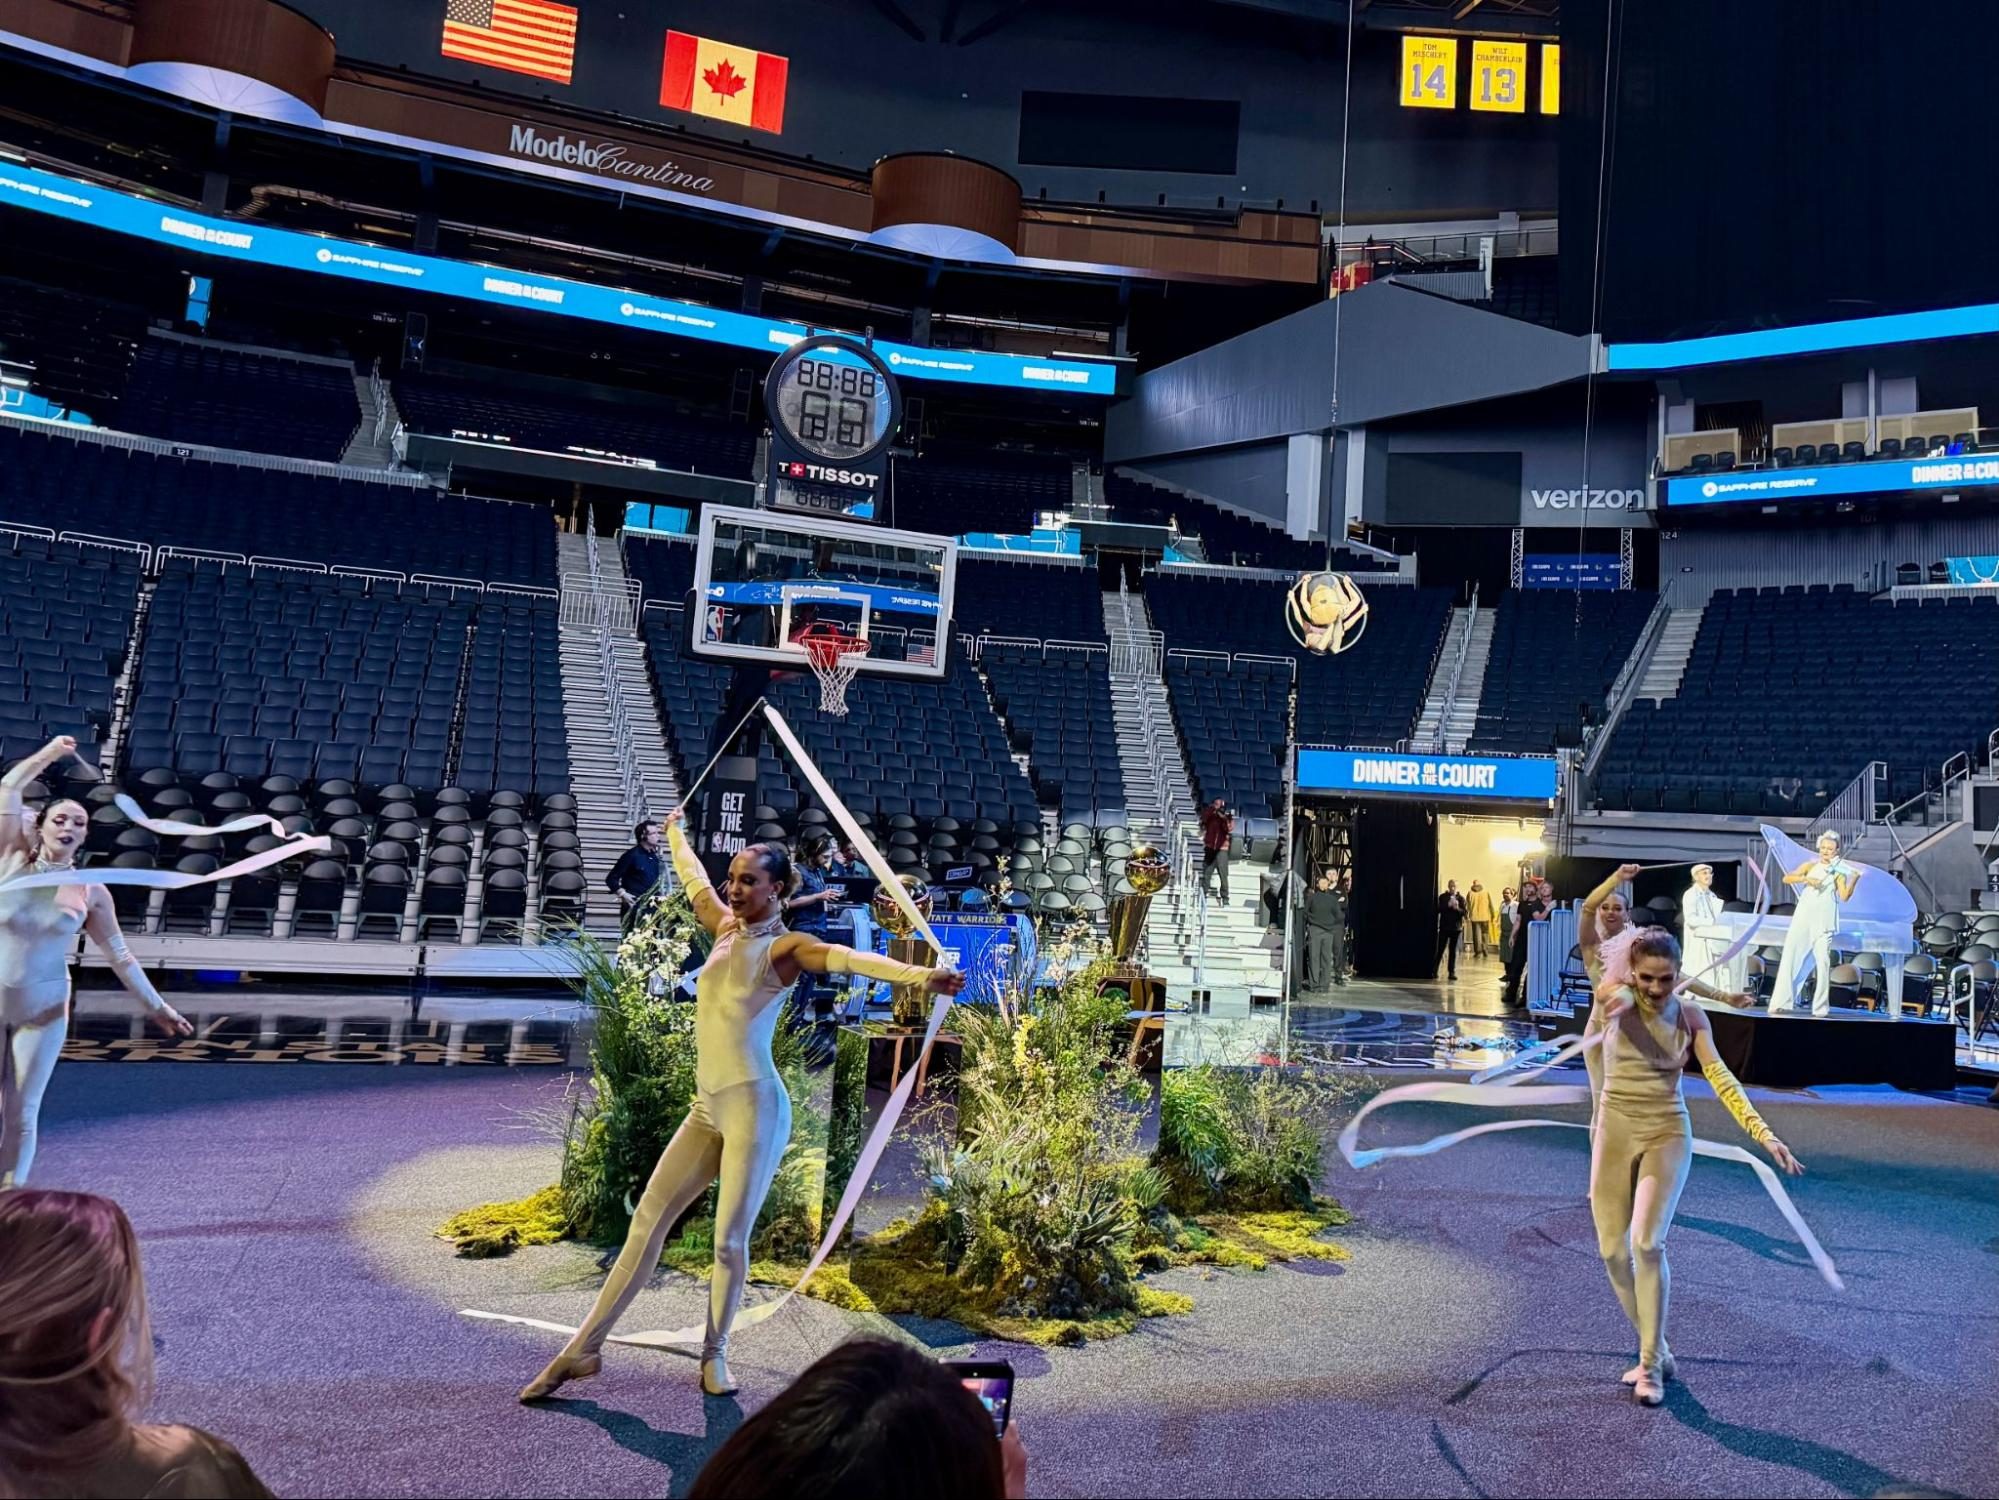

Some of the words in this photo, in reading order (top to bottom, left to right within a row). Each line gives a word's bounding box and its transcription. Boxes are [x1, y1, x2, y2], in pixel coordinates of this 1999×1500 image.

[1411, 63, 1446, 99] 14
[1480, 67, 1517, 103] 13
[509, 124, 601, 168] Modelo
[596, 142, 715, 192] Cantina
[176, 448, 190, 456] 121
[806, 464, 879, 489] TISSOT
[1911, 463, 1963, 484] DINNER
[1530, 484, 1645, 509] verizon
[1353, 758, 1420, 786] DINNER
[1421, 773, 1438, 786] THE
[1423, 762, 1436, 774] ON
[1438, 764, 1498, 789] COURT
[721, 791, 746, 812] GET
[720, 811, 744, 832] THE
[722, 832, 747, 857] App
[929, 914, 953, 923] TATE
[1961, 981, 1968, 991] 3
